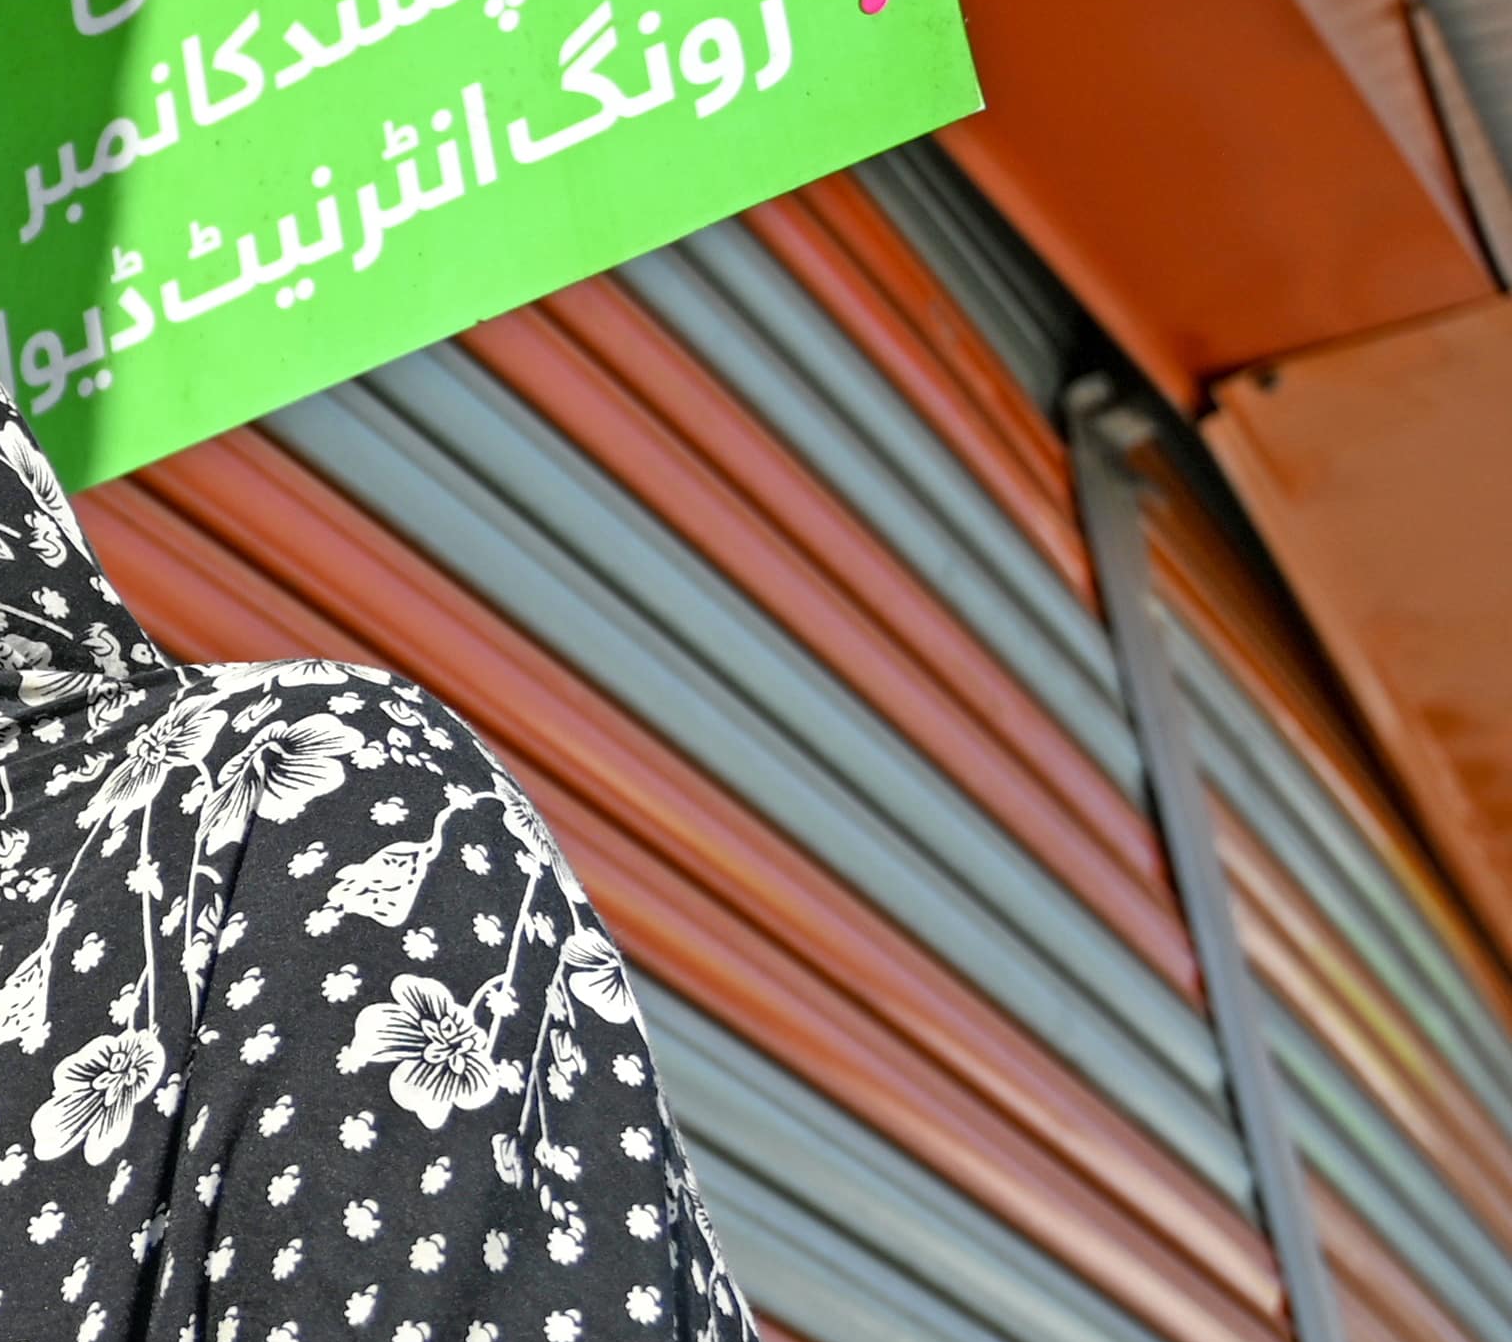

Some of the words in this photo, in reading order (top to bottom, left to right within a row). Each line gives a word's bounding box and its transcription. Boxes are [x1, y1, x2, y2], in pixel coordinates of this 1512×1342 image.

[19, 61, 182, 244] نمبر
[181, 10, 267, 127] کا
[160, 81, 500, 324] انٹرنیٹ
